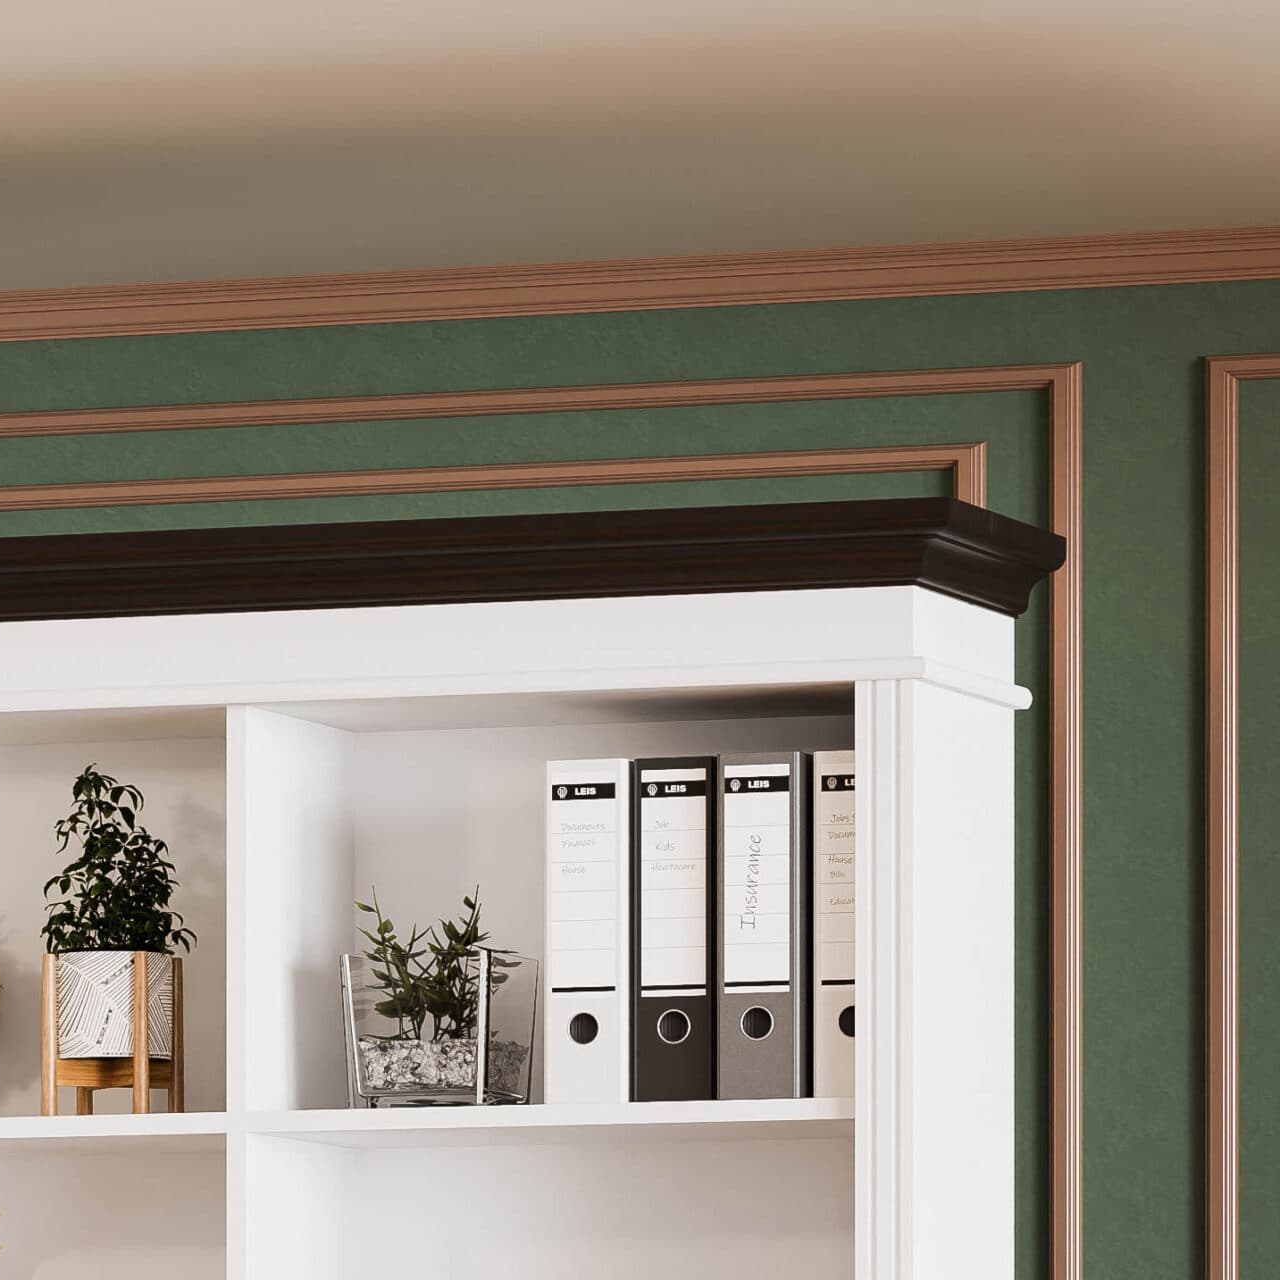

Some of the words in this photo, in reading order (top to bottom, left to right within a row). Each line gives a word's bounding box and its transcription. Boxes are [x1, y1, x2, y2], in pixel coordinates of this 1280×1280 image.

[665, 784, 687, 793] LEIS
[748, 780, 770, 788] LEIS
[575, 787, 597, 796] LEIS
[828, 854, 854, 864] House
[740, 834, 761, 929] Insurance
